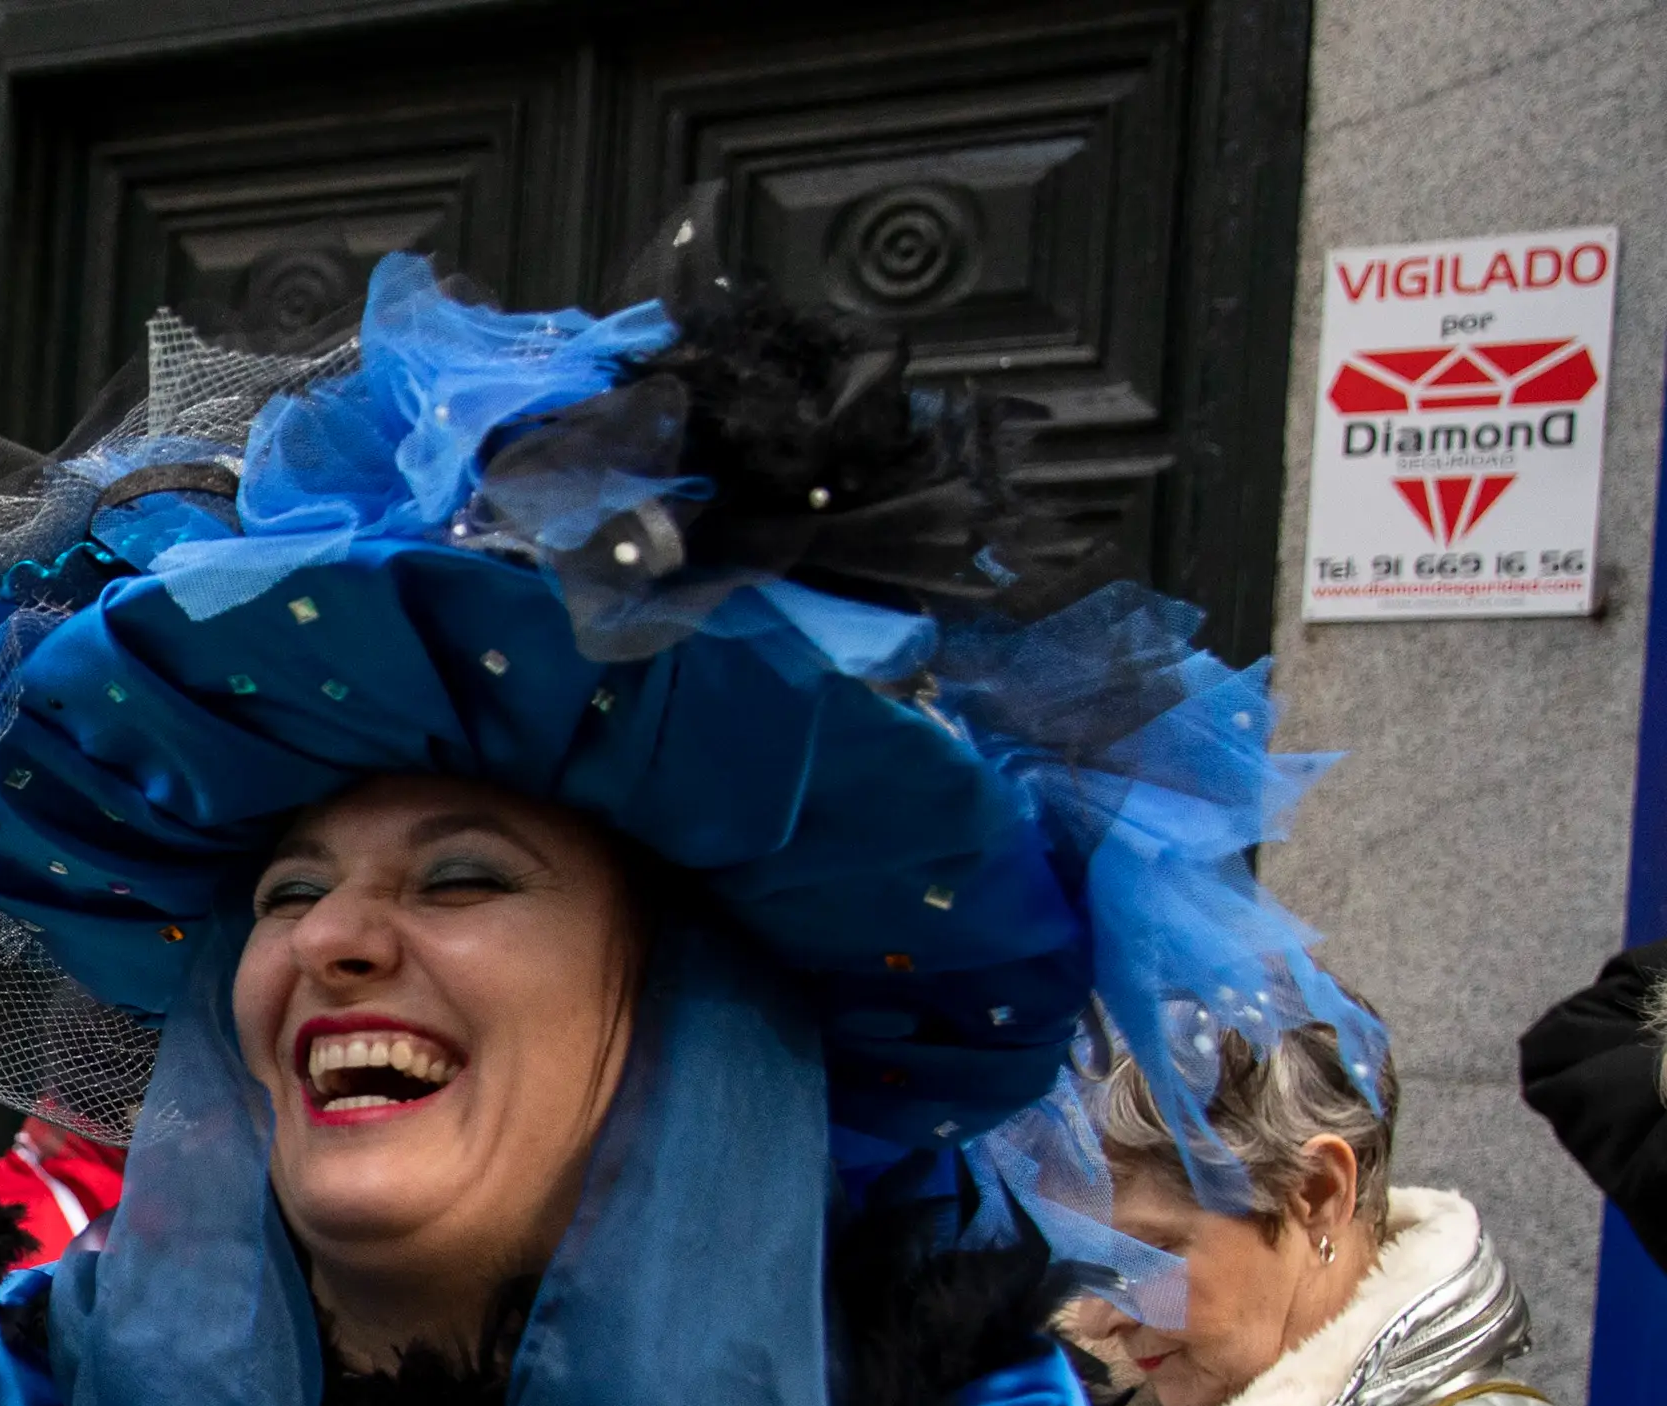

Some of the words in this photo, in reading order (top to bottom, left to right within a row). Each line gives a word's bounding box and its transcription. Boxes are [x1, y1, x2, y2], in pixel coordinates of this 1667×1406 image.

[1336, 241, 1608, 303] VIGILADO
[1440, 312, 1495, 339] por
[1395, 454, 1515, 472] SEGURIDAD
[1371, 554, 1403, 581] 91
[1414, 552, 1485, 580] 669
[1495, 550, 1527, 578] 16
[1539, 549, 1586, 577] 56
